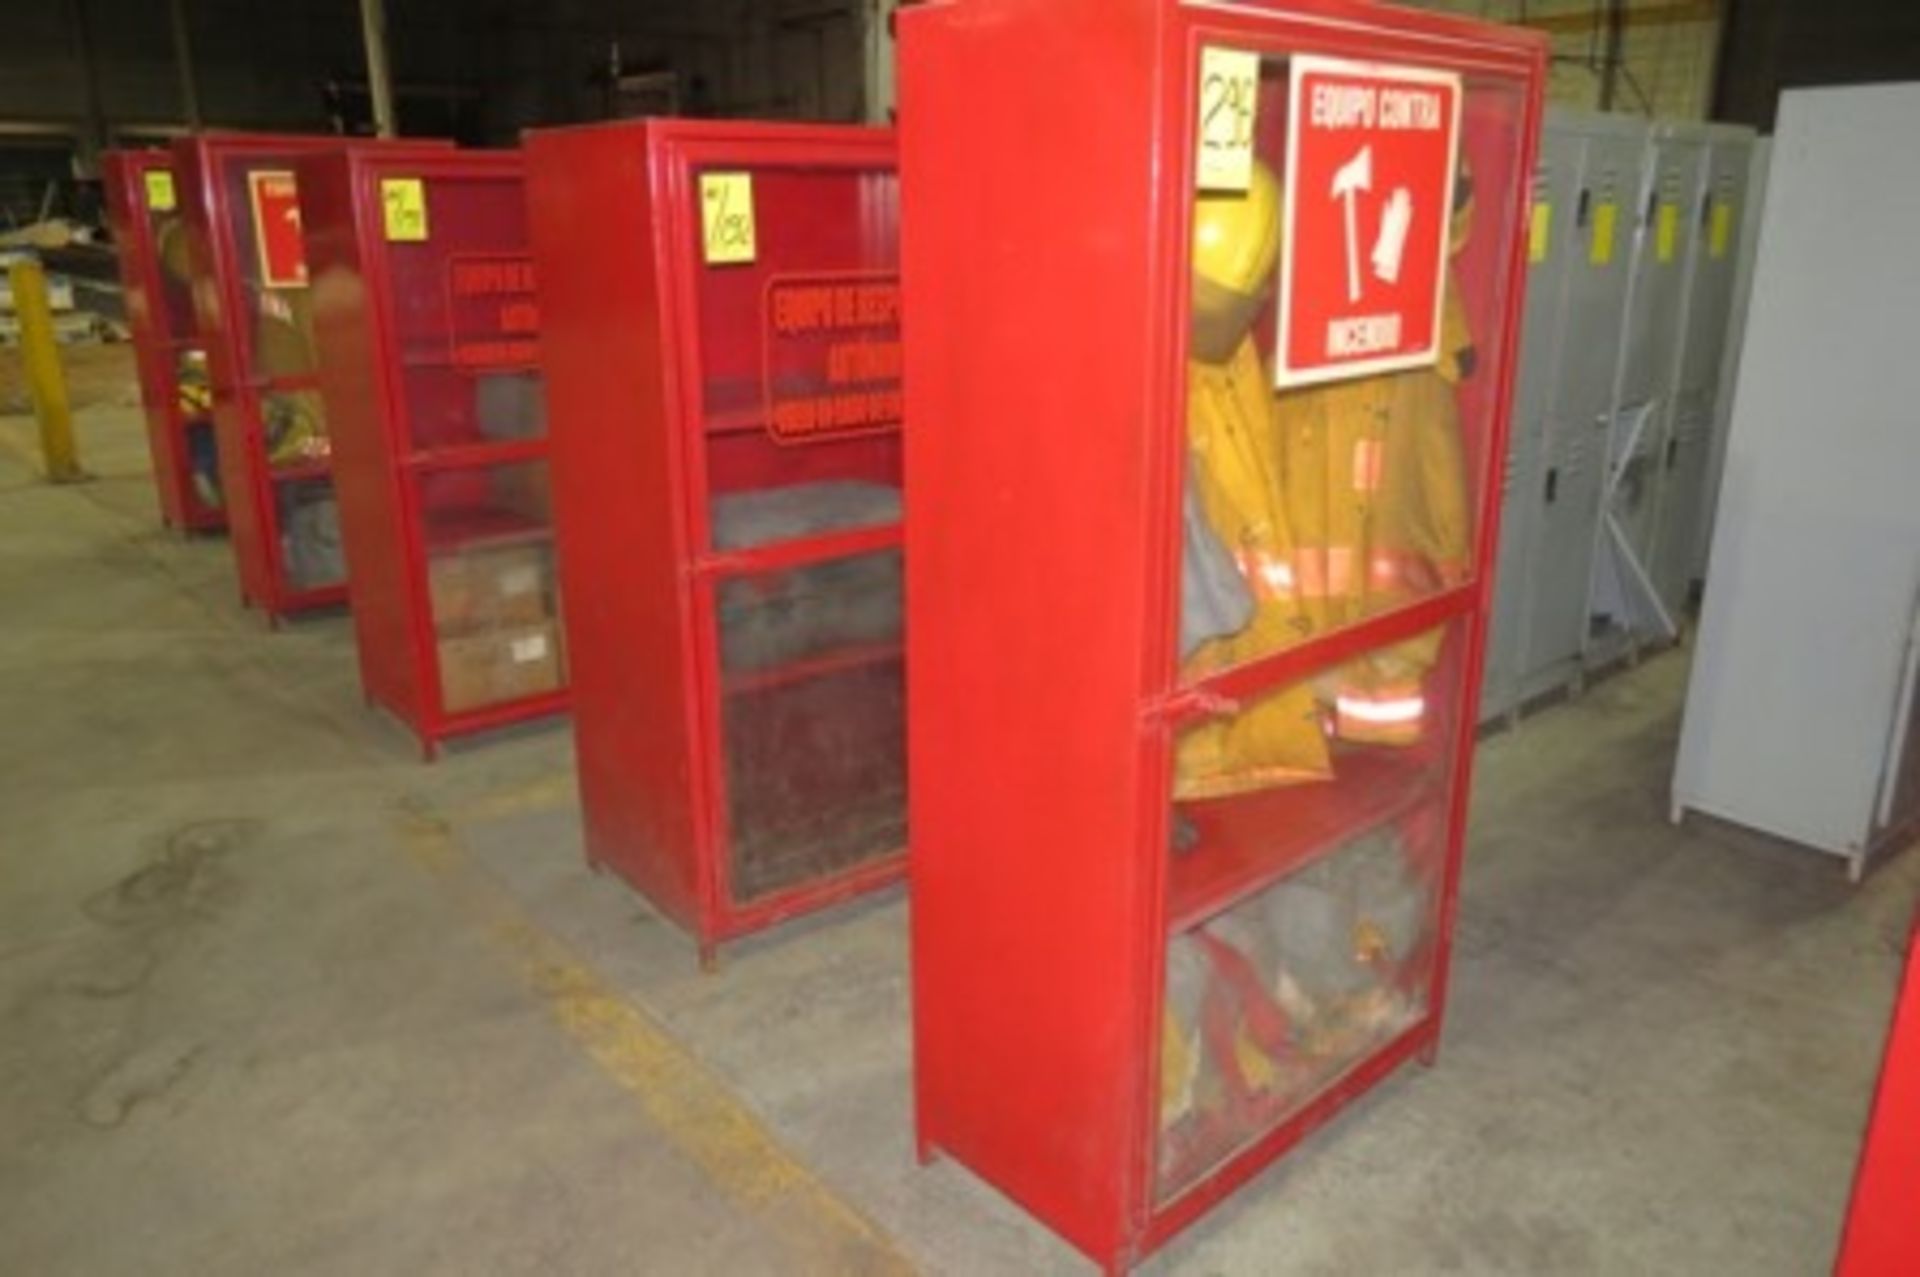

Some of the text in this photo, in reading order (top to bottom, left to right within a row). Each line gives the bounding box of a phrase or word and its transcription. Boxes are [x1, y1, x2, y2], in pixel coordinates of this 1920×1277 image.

[1310, 82, 1442, 131] EQUIPO CONTRA
[1327, 311, 1402, 359] INCENDIO
